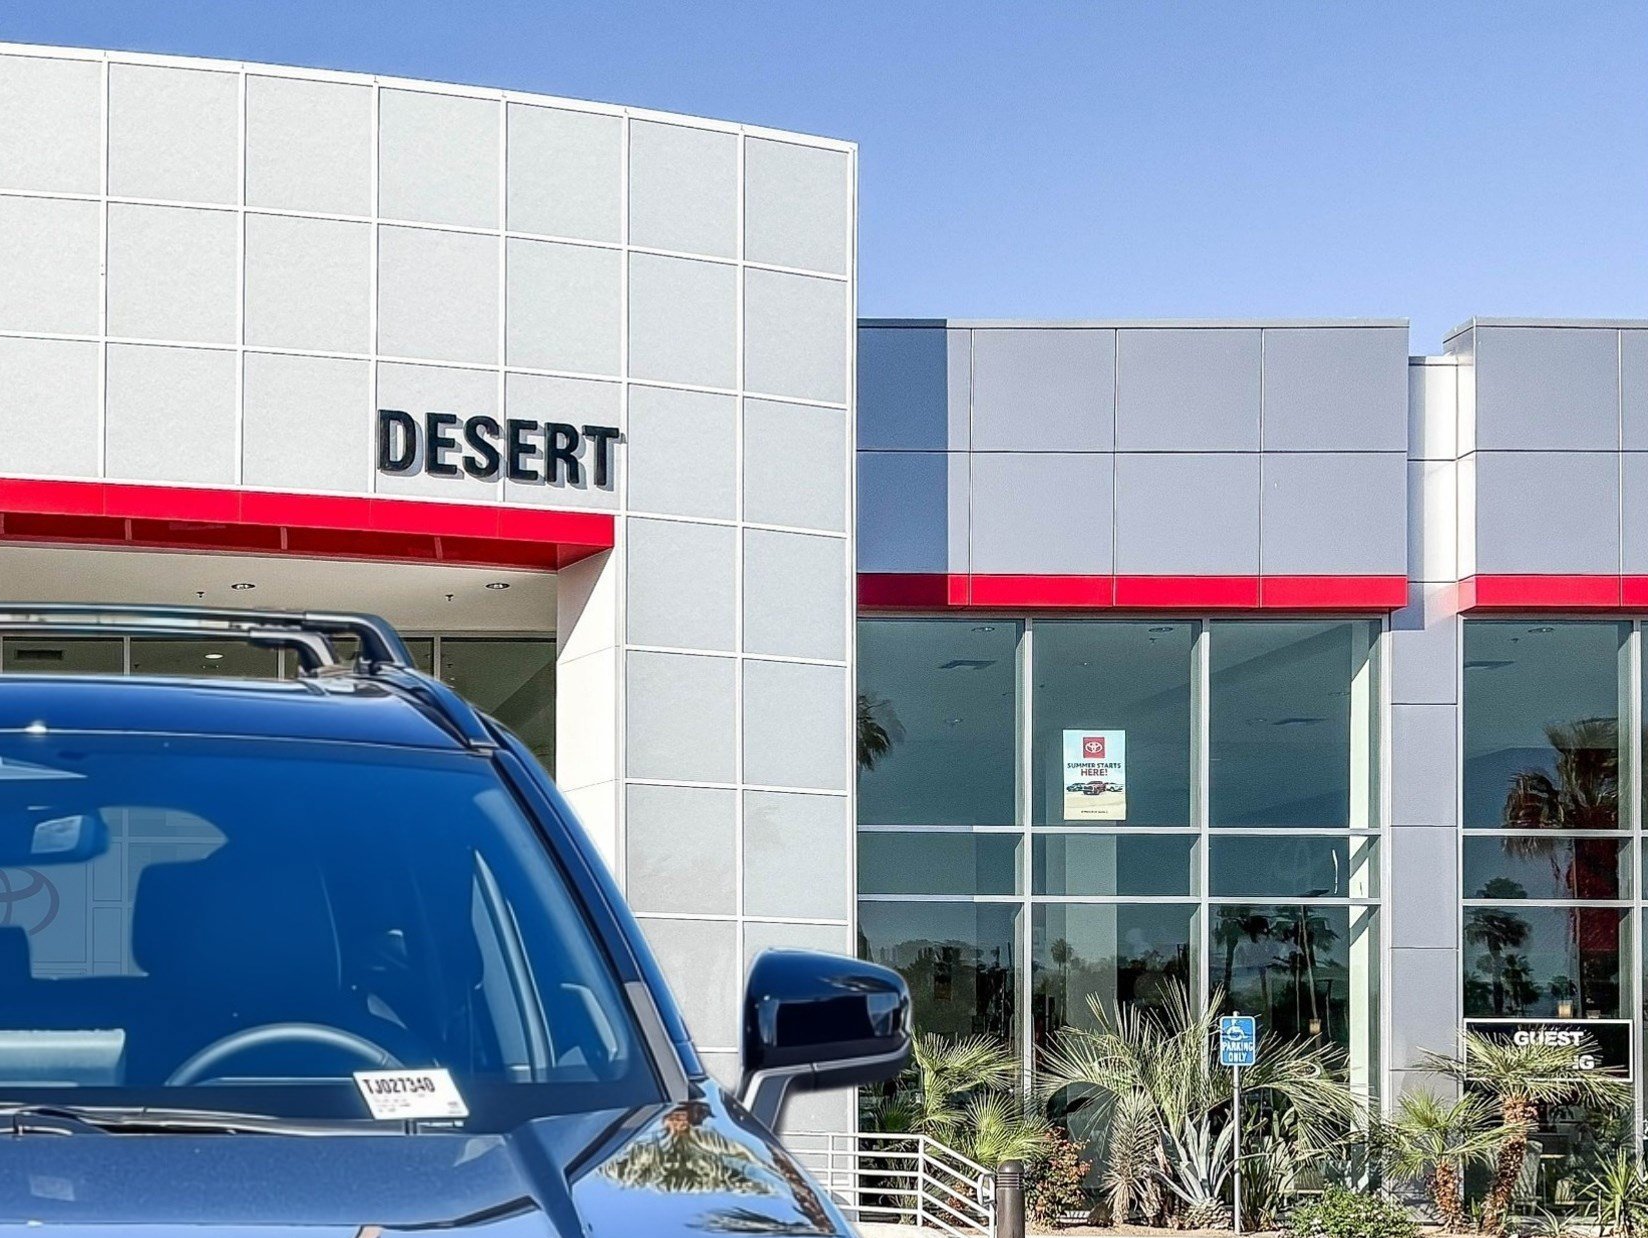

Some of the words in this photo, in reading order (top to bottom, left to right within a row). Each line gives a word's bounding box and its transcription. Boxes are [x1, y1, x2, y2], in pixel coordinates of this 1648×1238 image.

[377, 409, 620, 487] DESERT
[1080, 768, 1108, 777] HERE!
[1513, 1030, 1584, 1047] GUEST
[1222, 1041, 1253, 1051] PARKING
[1228, 1052, 1247, 1062] ONLY
[362, 1076, 436, 1095] TJ027340
